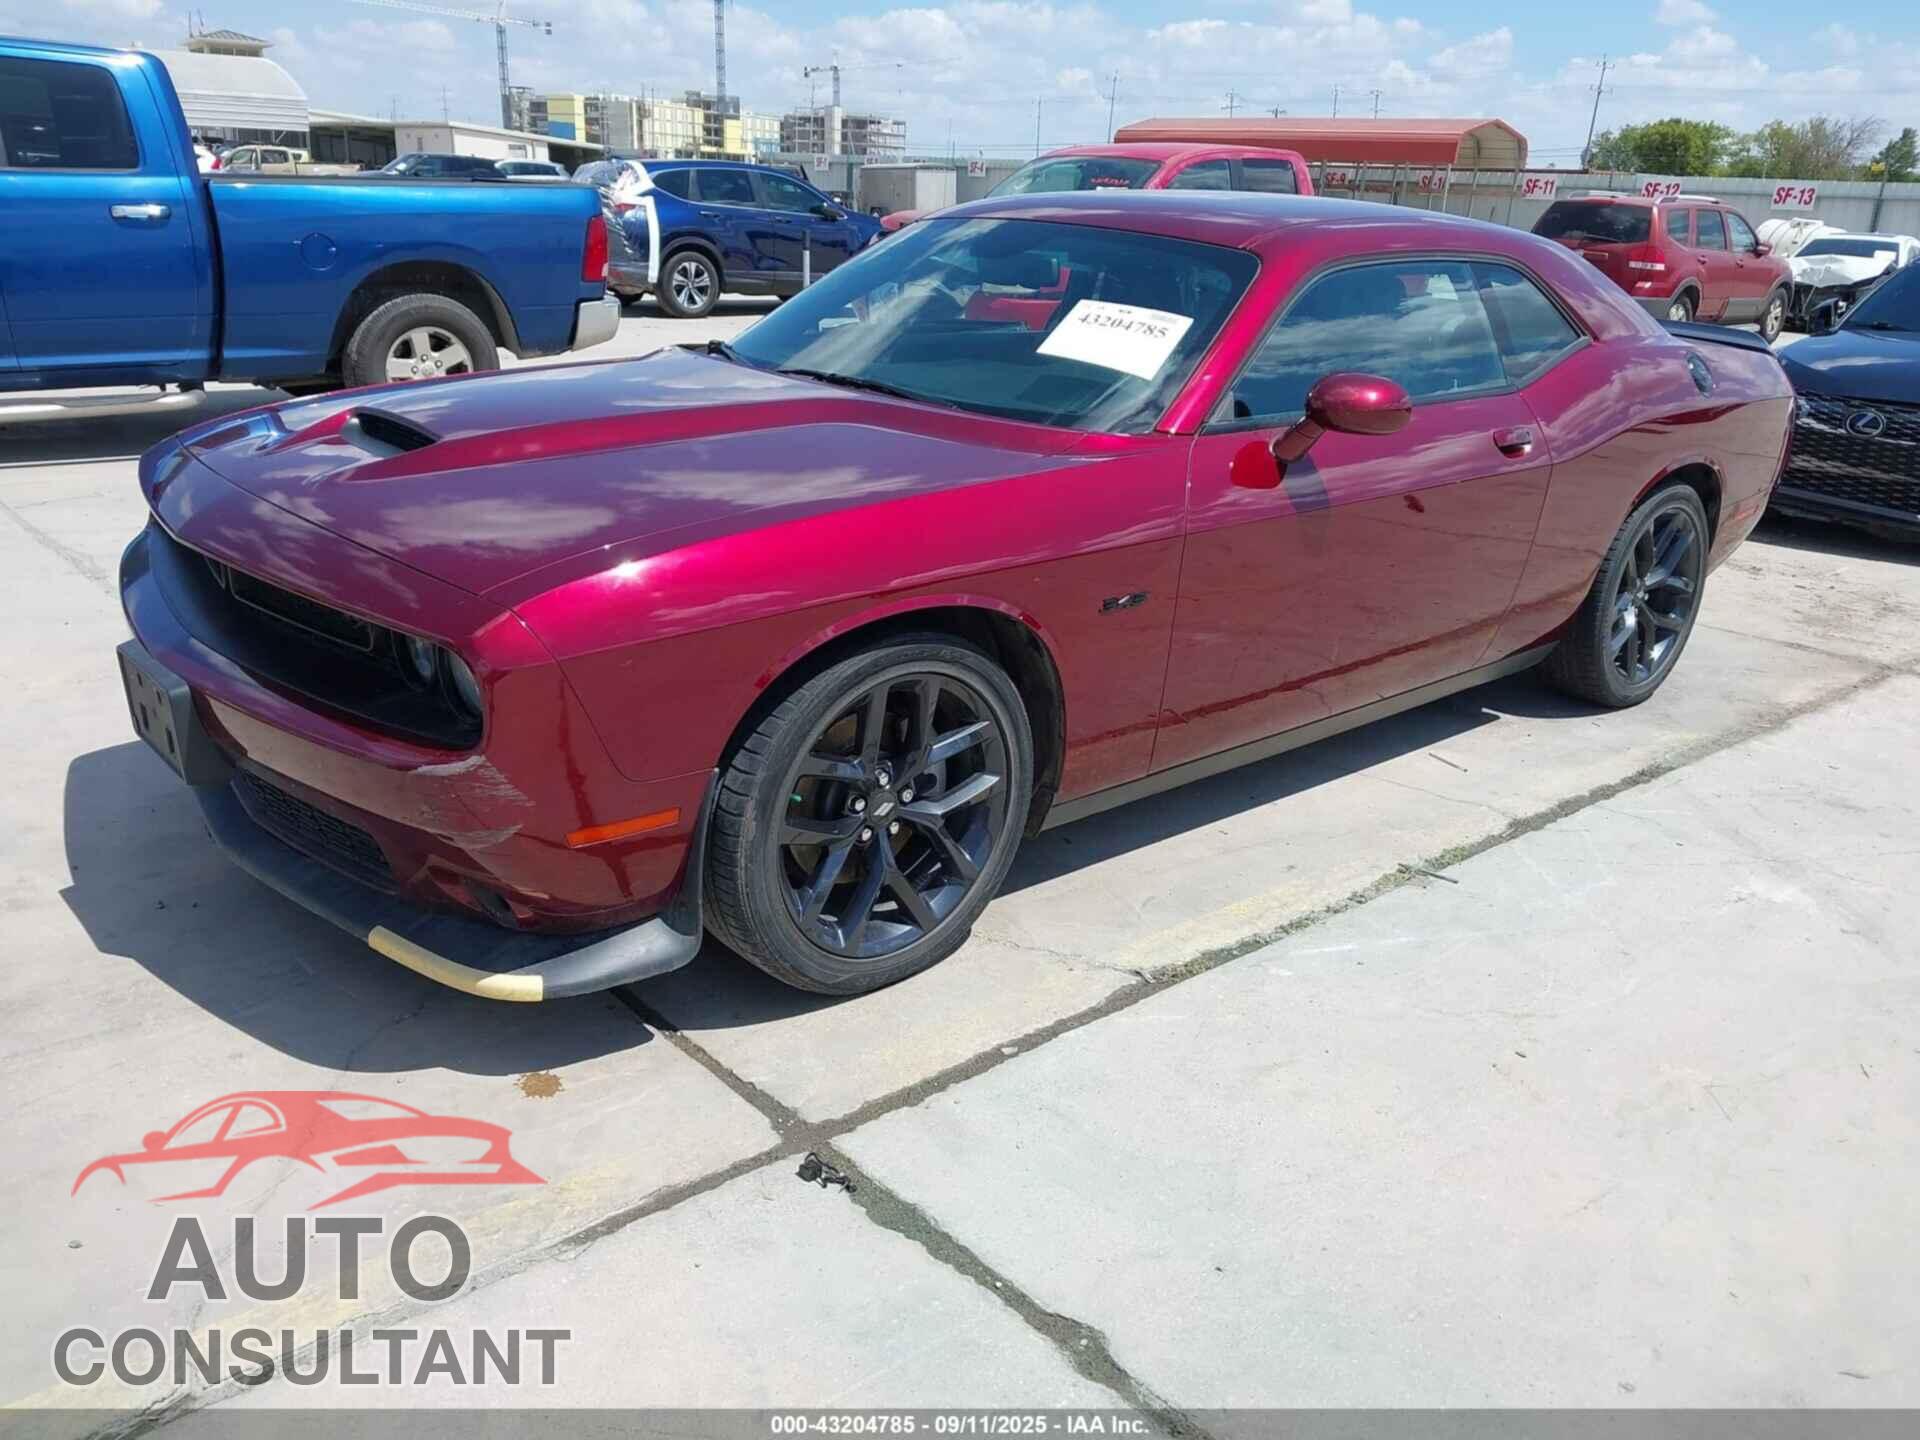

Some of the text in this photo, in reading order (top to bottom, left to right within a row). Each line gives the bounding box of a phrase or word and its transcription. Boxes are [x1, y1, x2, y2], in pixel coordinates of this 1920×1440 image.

[1523, 178, 1555, 194] SF-11
[1642, 182, 1680, 198] SF-12
[1773, 186, 1816, 205] SF-13
[1078, 311, 1169, 339] 43204785
